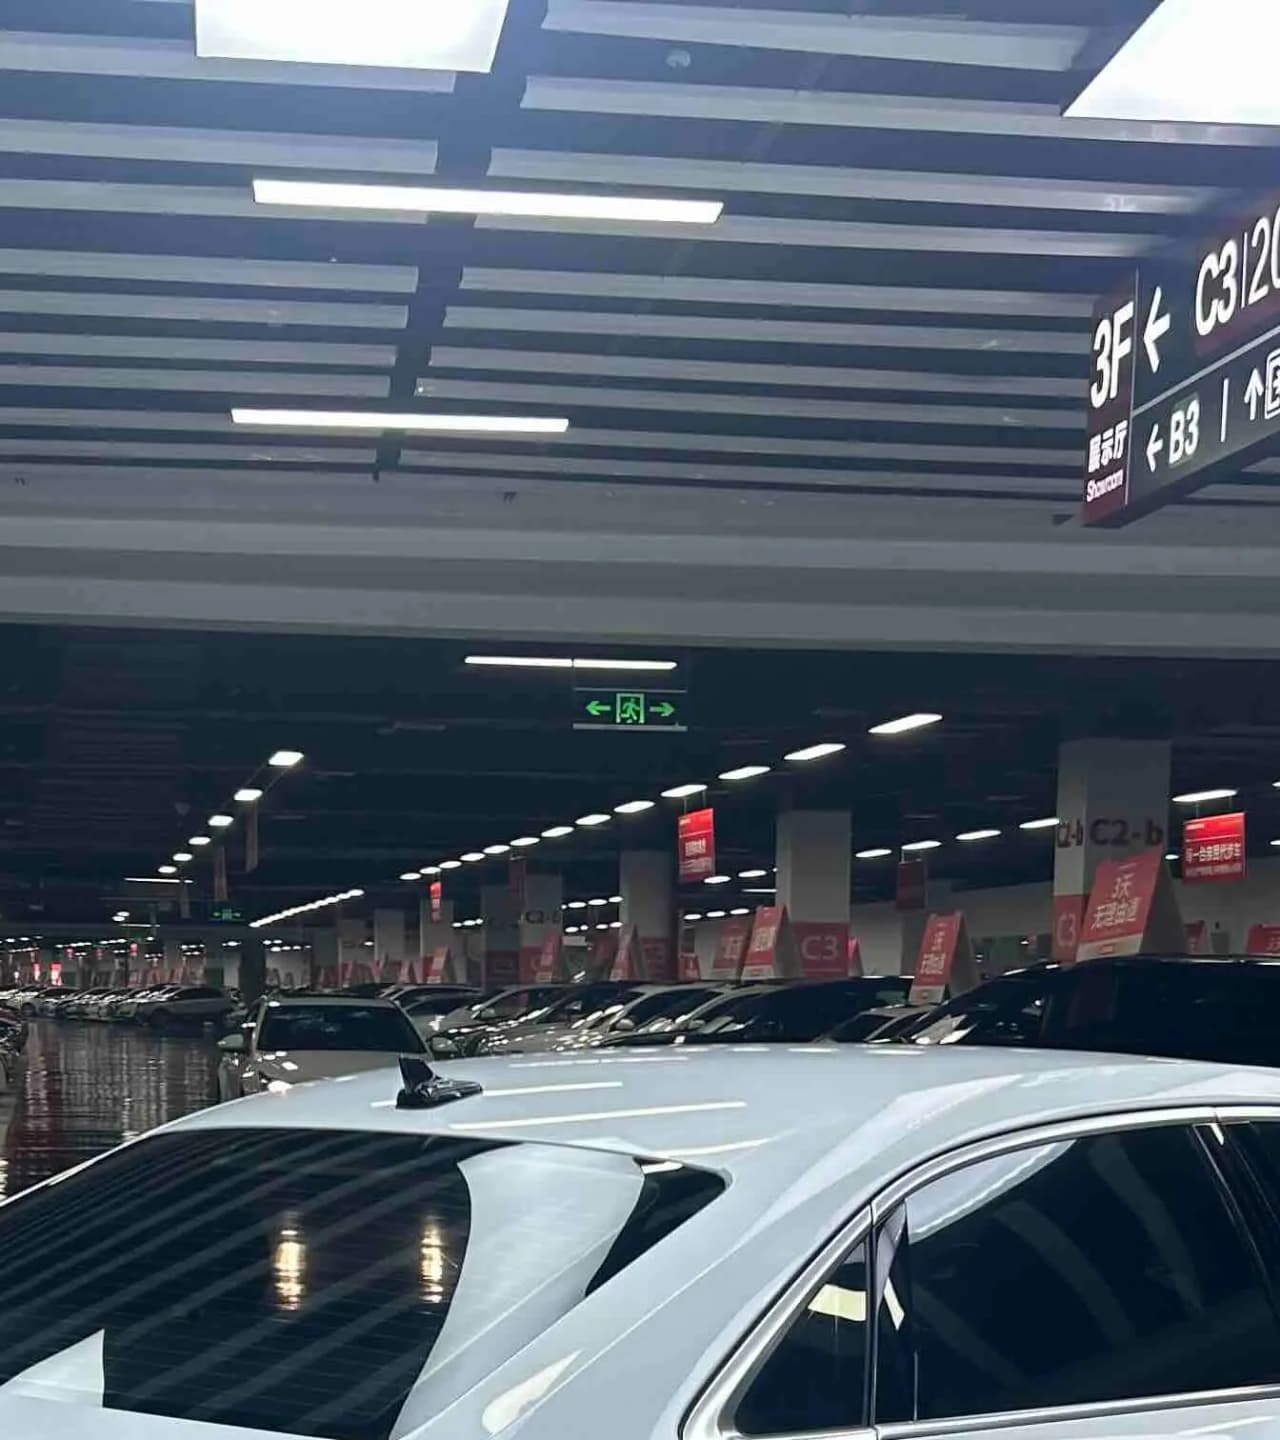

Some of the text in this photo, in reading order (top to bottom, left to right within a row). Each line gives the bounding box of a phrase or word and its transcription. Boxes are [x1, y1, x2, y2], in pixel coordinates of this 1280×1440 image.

[1090, 301, 1134, 409] 3F
[1088, 420, 1128, 473] 展示厅
[1169, 399, 1200, 465] B3
[1086, 468, 1124, 503] Showroom
[1089, 818, 1164, 846] C2-b
[801, 935, 838, 960] C3
